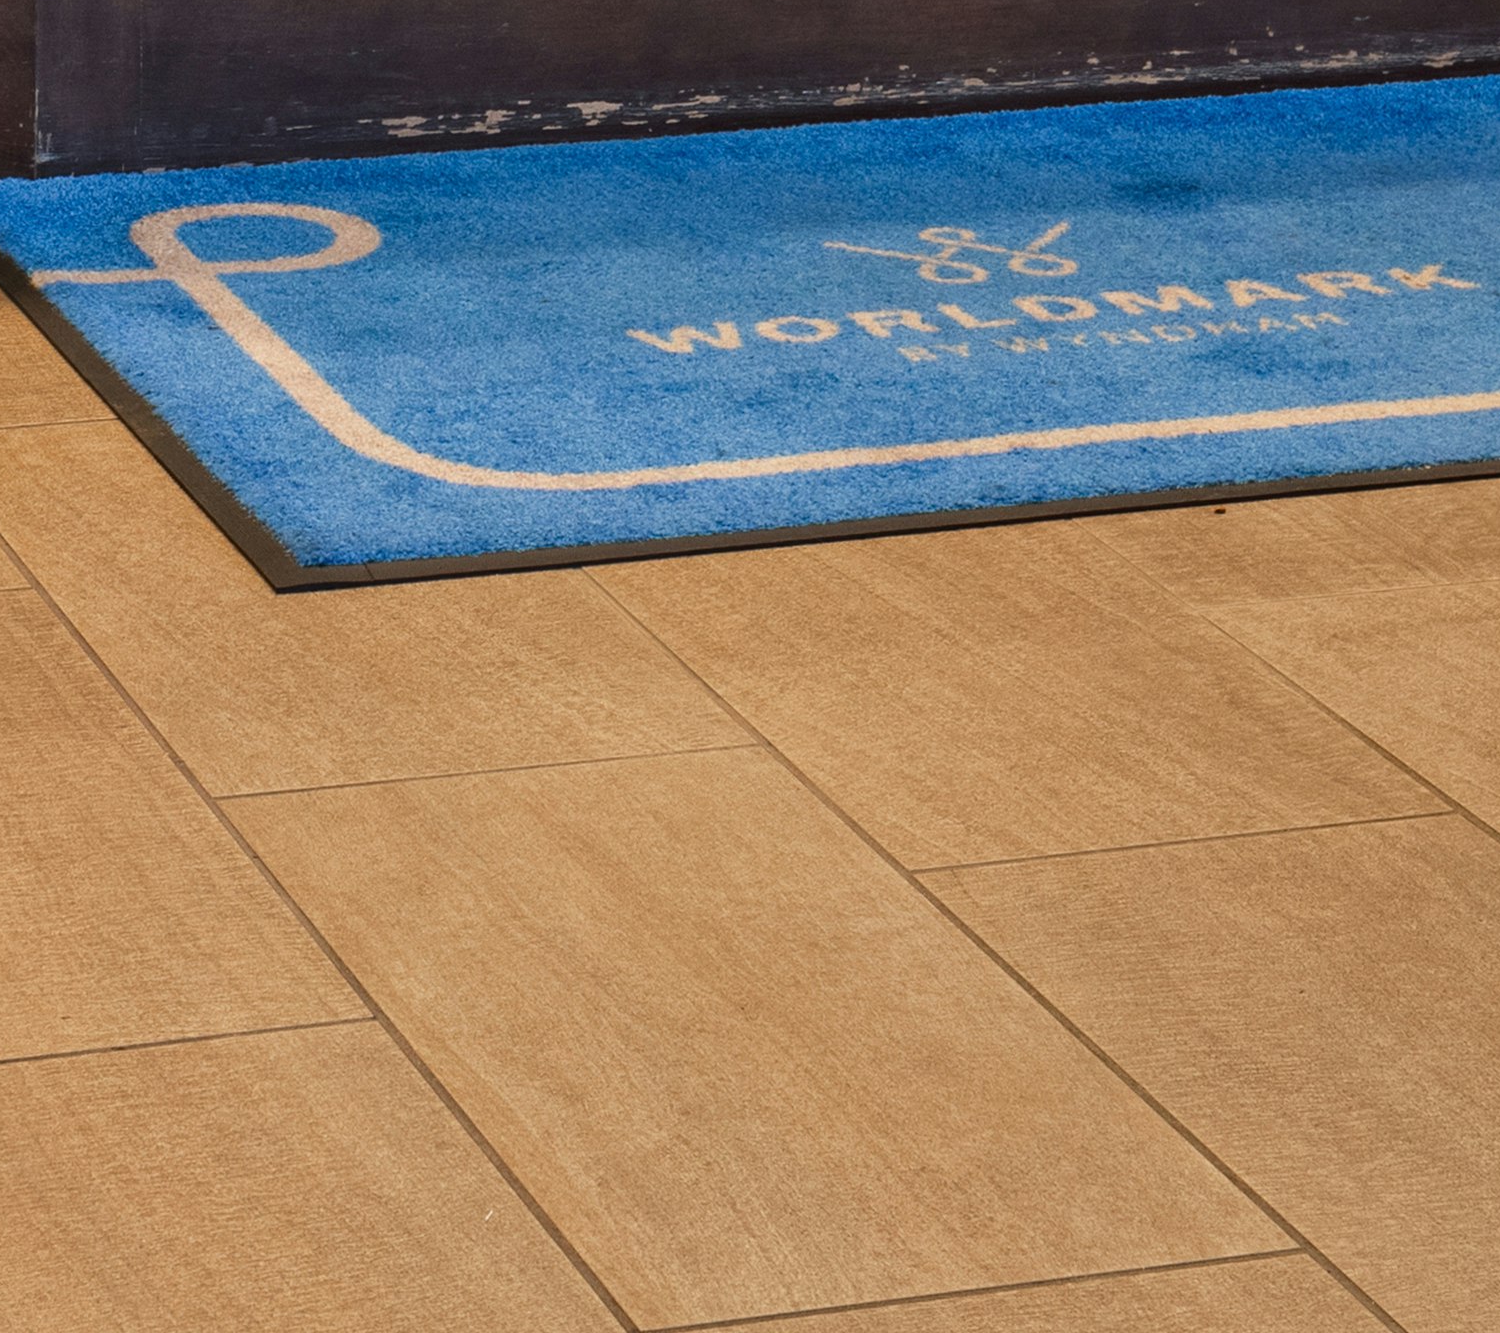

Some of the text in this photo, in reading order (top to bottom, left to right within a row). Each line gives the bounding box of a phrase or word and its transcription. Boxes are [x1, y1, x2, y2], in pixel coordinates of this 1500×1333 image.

[626, 263, 1481, 354] WORLDMARK
[898, 312, 1349, 362] BY WYNDHAM
